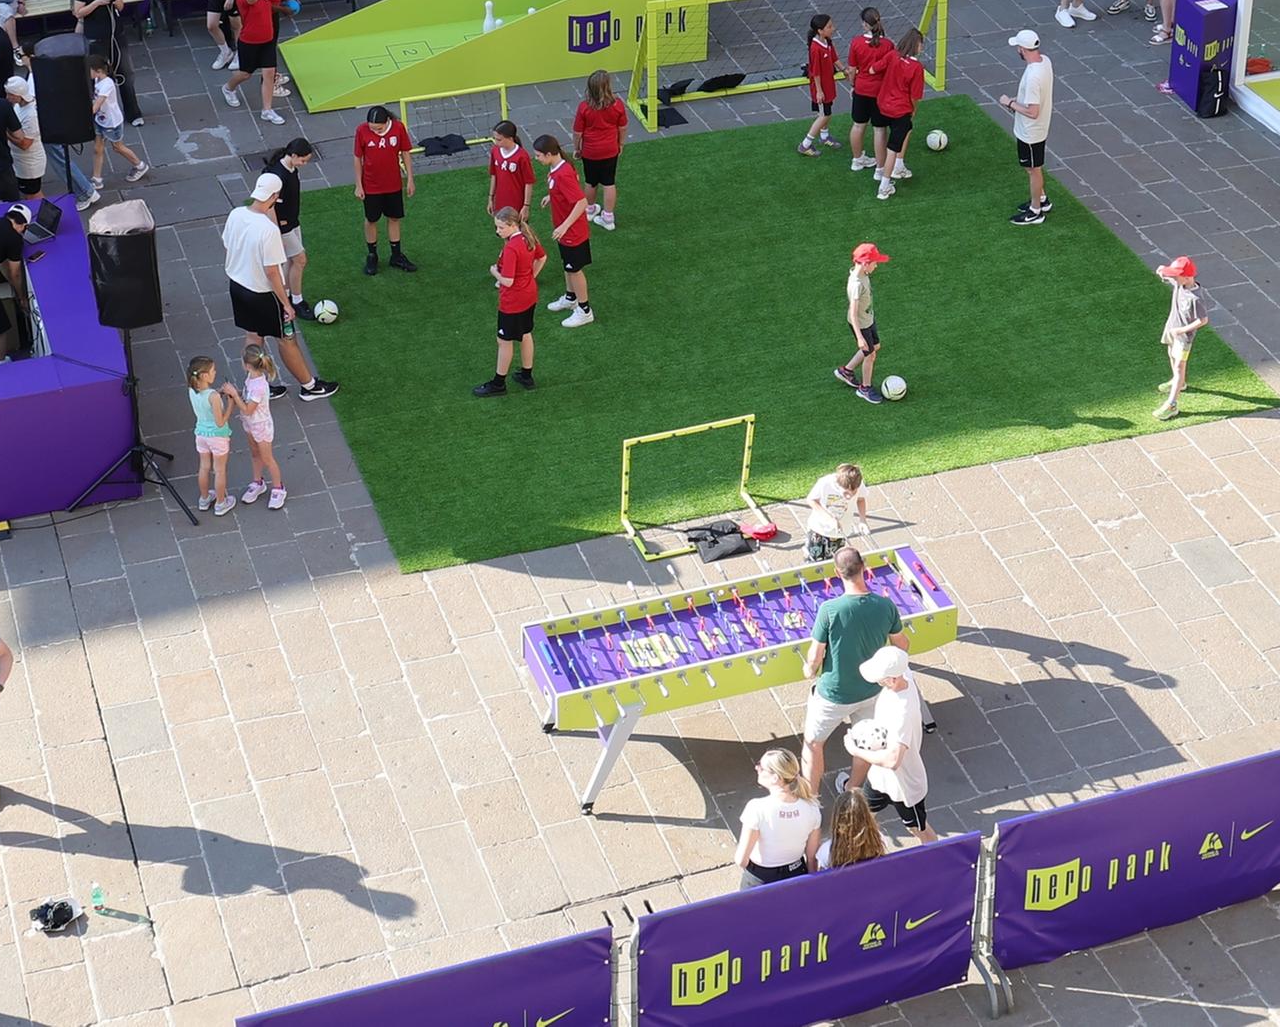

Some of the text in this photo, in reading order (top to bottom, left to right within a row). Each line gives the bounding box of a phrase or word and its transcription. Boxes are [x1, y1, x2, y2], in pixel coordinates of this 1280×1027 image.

[573, 6, 686, 47] hero prk
[1031, 841, 1171, 904] hero park
[677, 931, 828, 999] hero park
